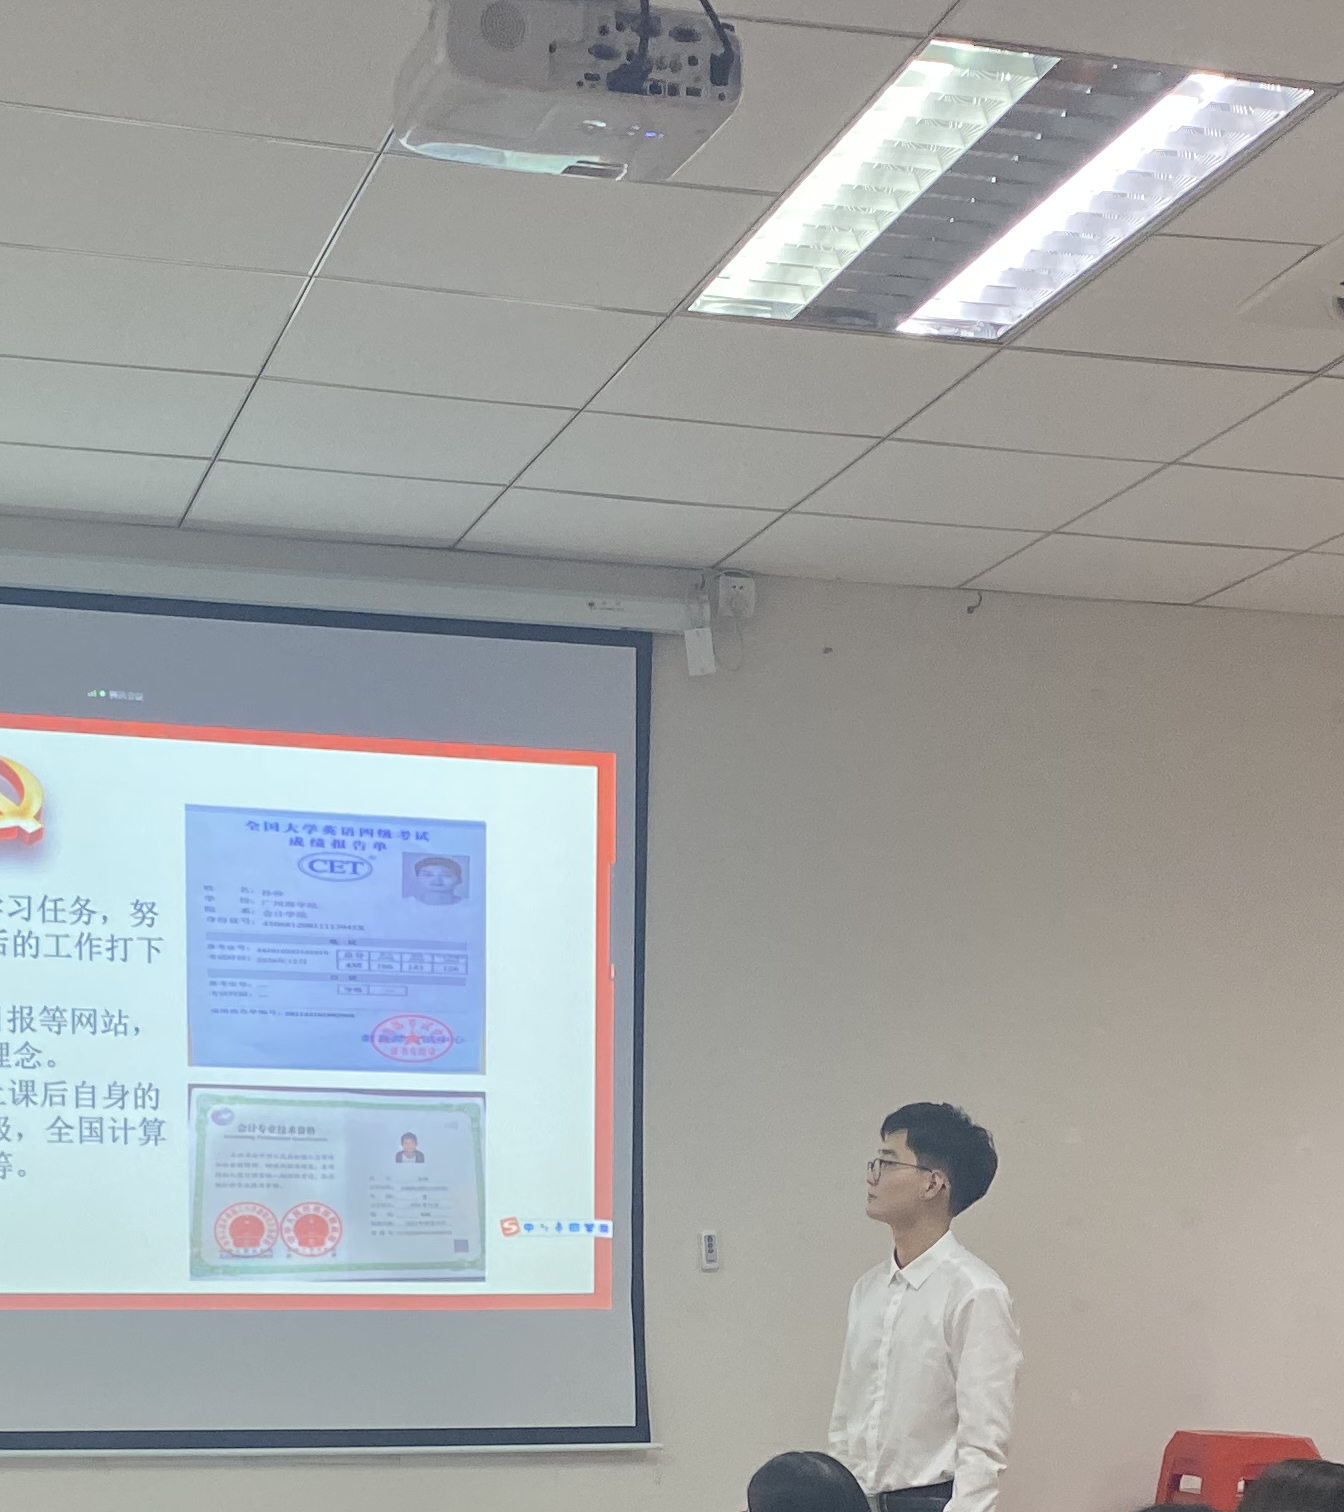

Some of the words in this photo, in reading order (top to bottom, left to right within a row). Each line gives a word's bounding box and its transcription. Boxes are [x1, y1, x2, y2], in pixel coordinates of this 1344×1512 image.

[244, 819, 430, 843] 全国大学英语四级考试
[288, 836, 388, 852] 成绩报告单
[307, 858, 365, 876] CET
